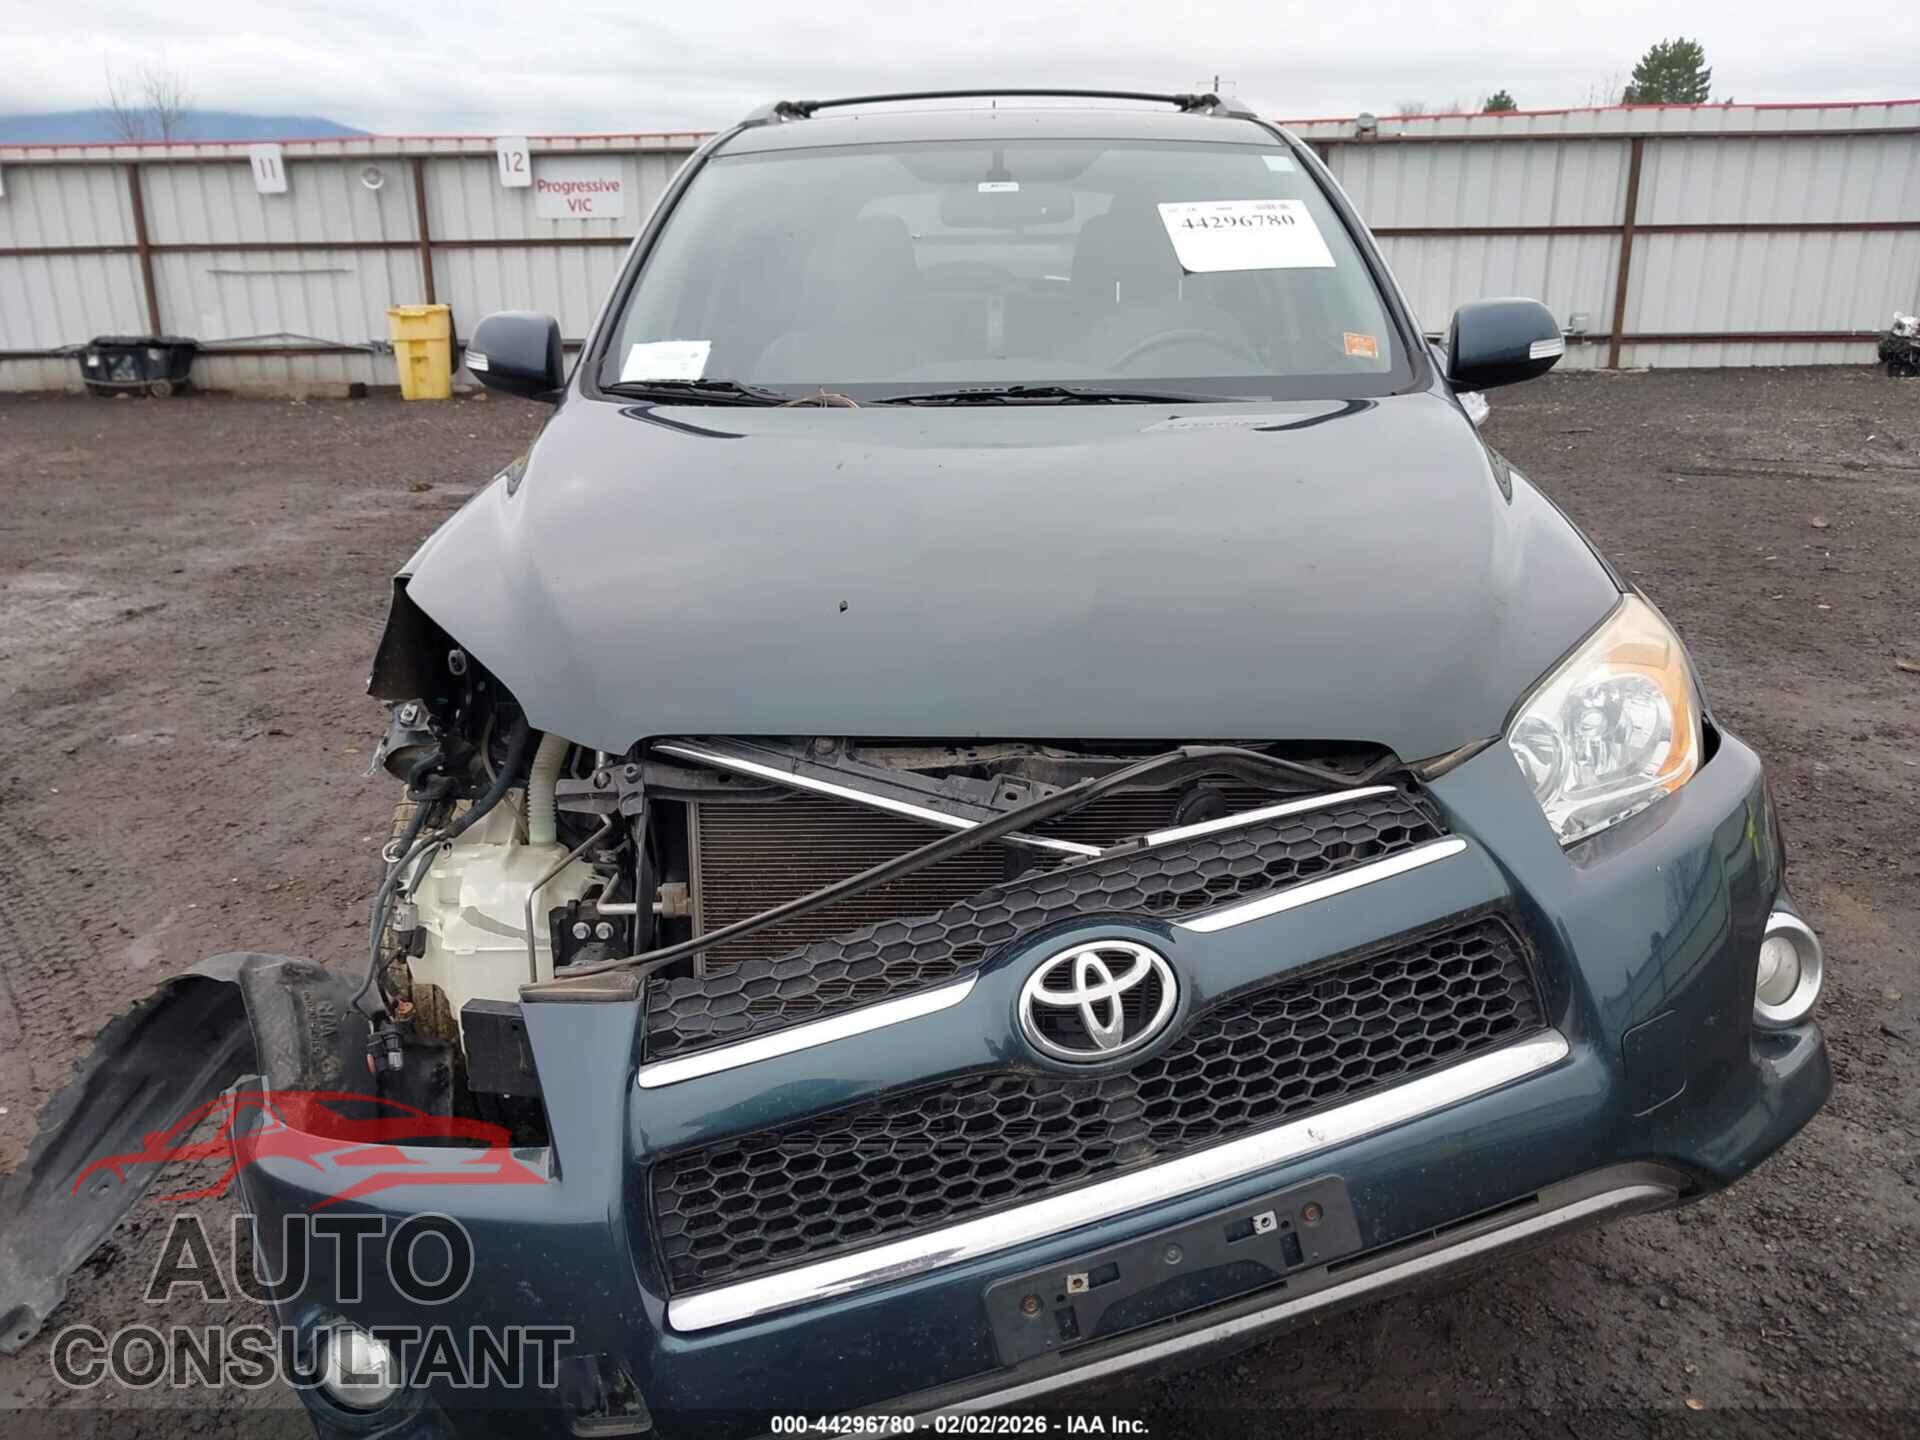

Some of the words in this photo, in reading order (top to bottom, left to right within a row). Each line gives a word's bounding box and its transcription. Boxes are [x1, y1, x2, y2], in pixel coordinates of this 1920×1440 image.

[258, 157, 277, 179] 11
[503, 151, 525, 173] 12
[537, 179, 620, 195] Progressive
[567, 198, 593, 213] VIC
[1182, 213, 1296, 230] 44296780
